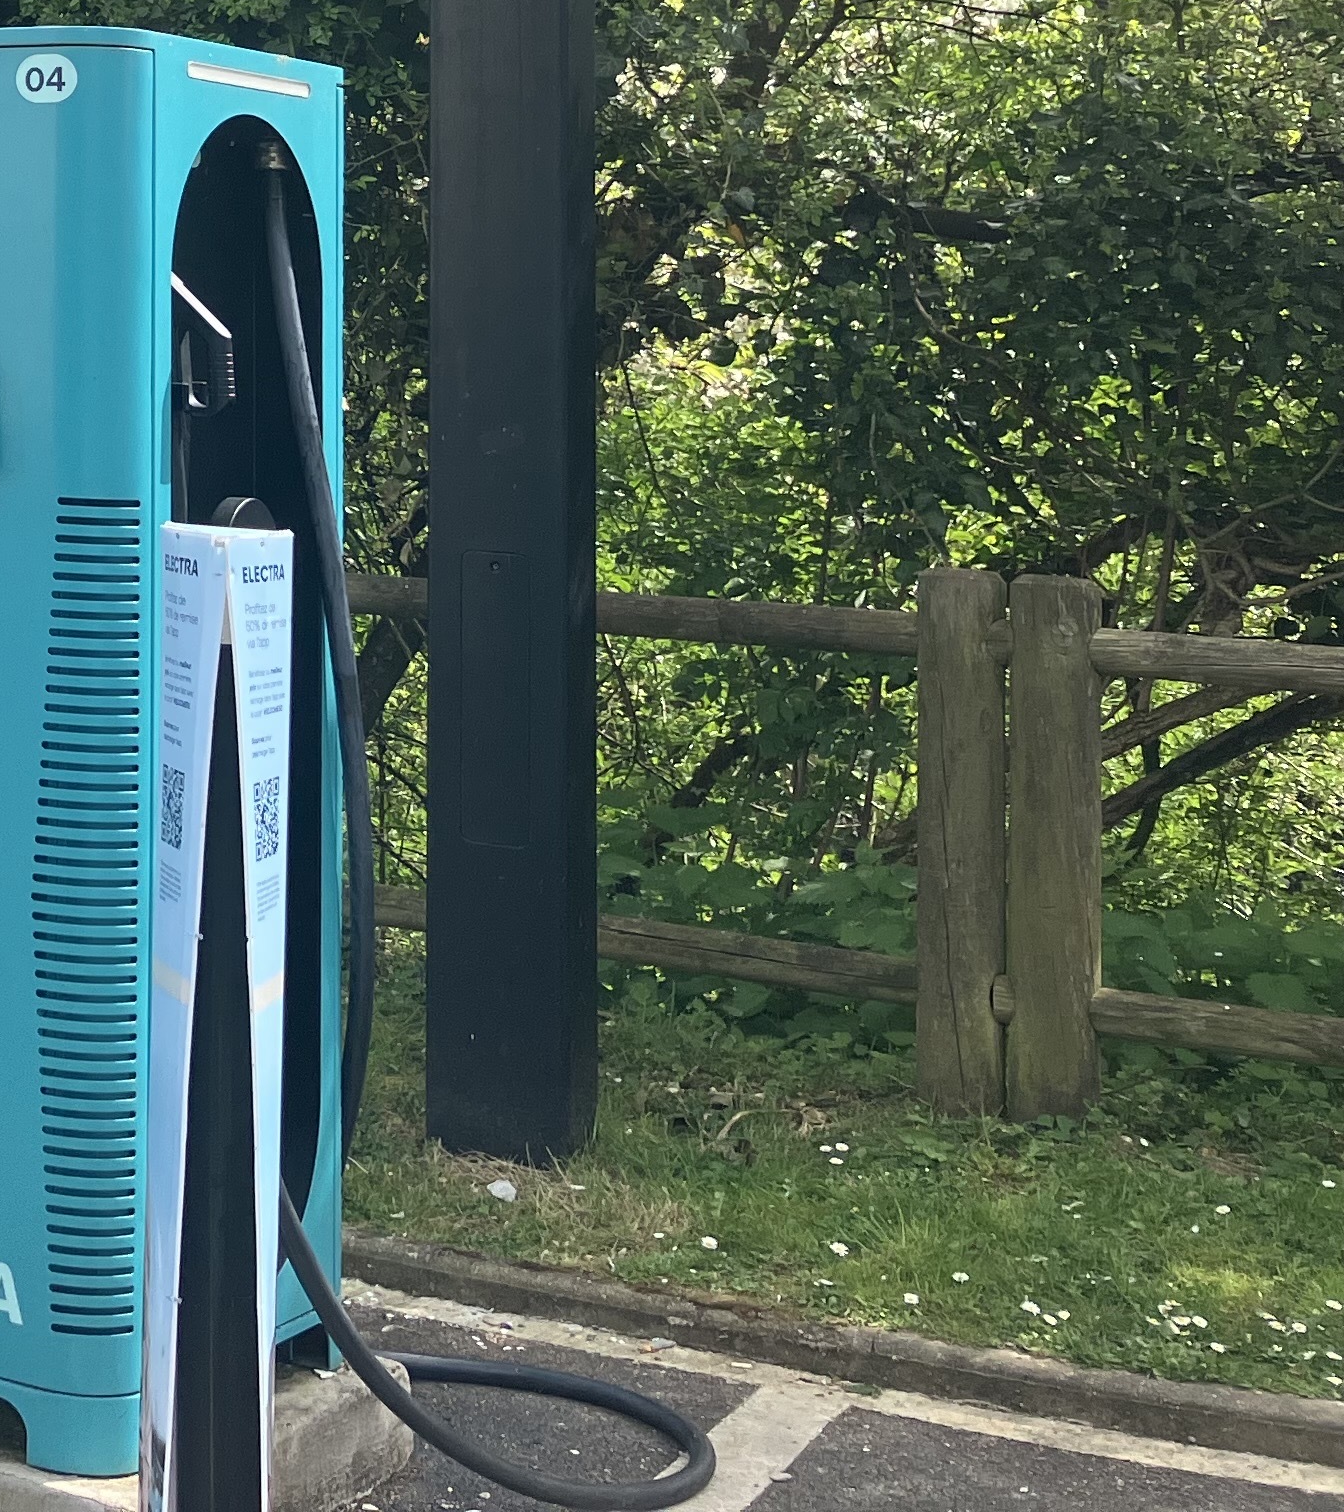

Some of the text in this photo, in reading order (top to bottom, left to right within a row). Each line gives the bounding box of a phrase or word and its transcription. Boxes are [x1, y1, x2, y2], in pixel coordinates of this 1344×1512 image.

[25, 66, 66, 92] 04
[164, 553, 199, 578] ELECTRA
[241, 564, 286, 584] ELECTRA
